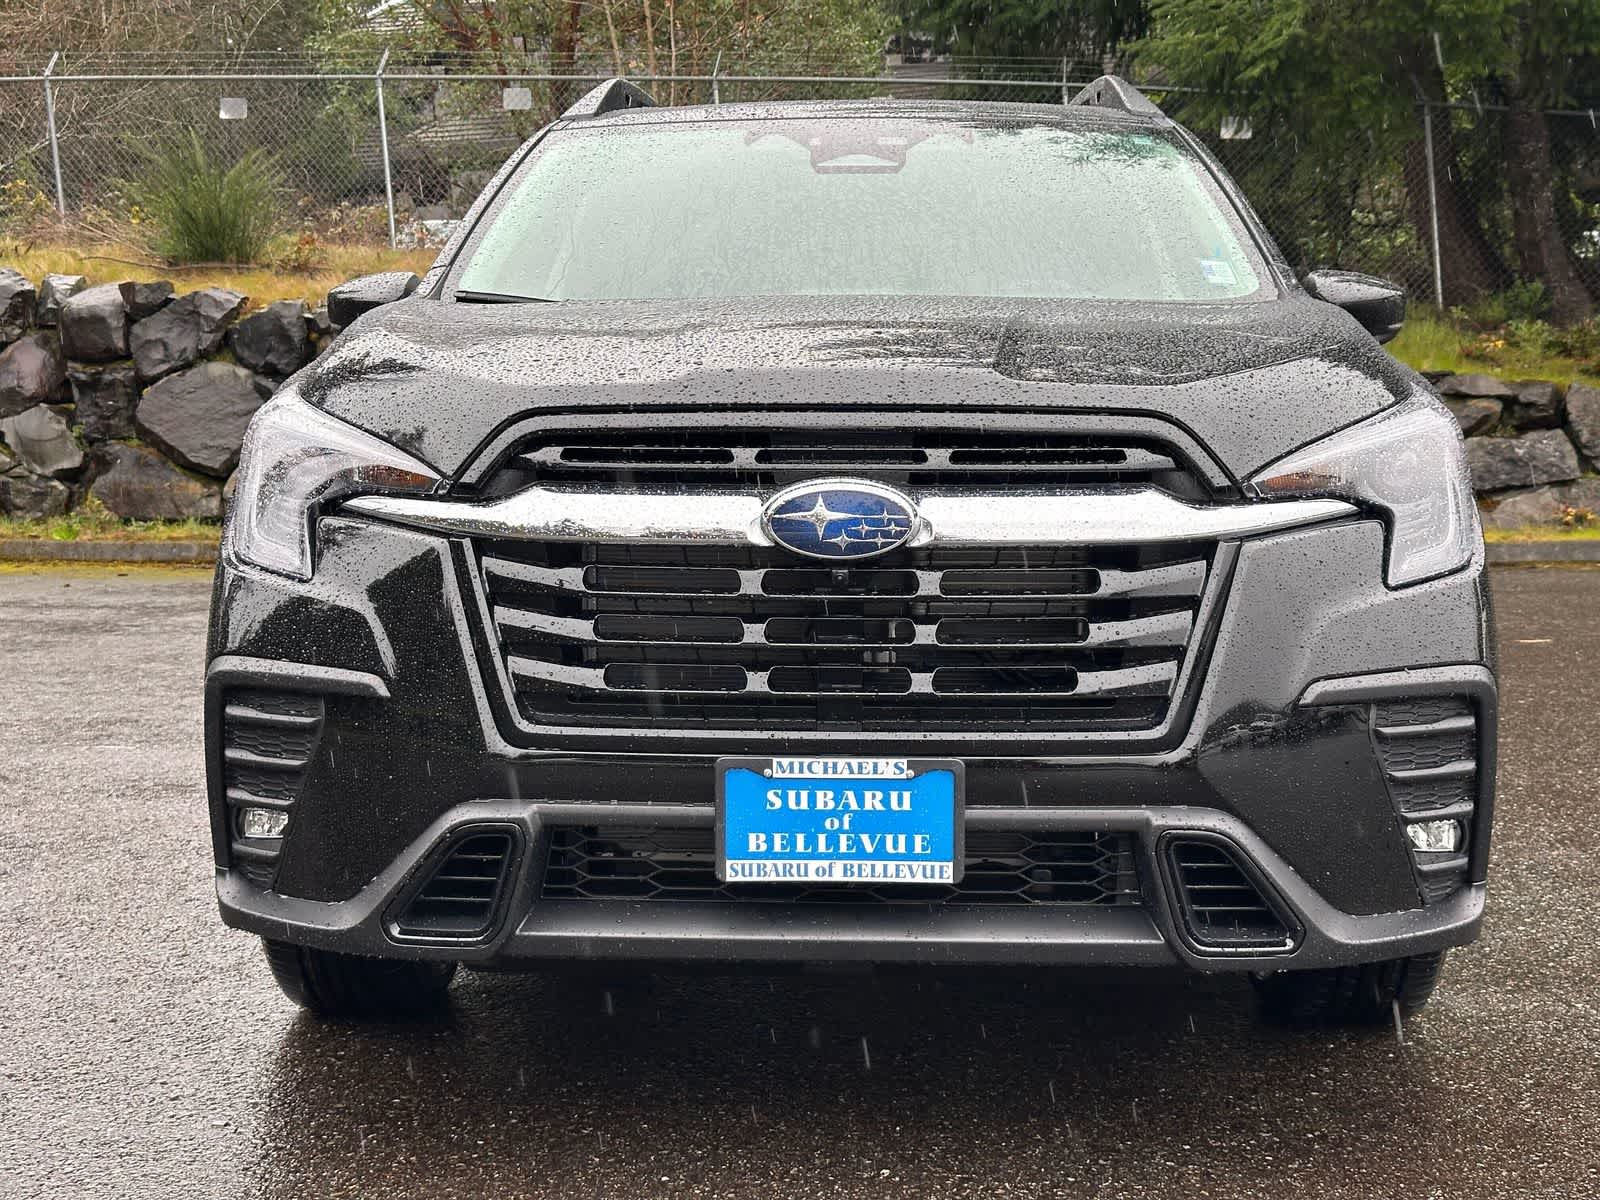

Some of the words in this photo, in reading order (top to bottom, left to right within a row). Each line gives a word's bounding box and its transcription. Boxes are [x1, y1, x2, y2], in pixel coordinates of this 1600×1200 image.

[775, 760, 905, 775] MICHAEL'S
[766, 789, 913, 811] SUBARU
[824, 813, 853, 831] of
[747, 832, 932, 854] BELLEVUE
[729, 862, 809, 878] SUBARU
[814, 862, 836, 878] of
[842, 862, 951, 880] BELLEVUE
